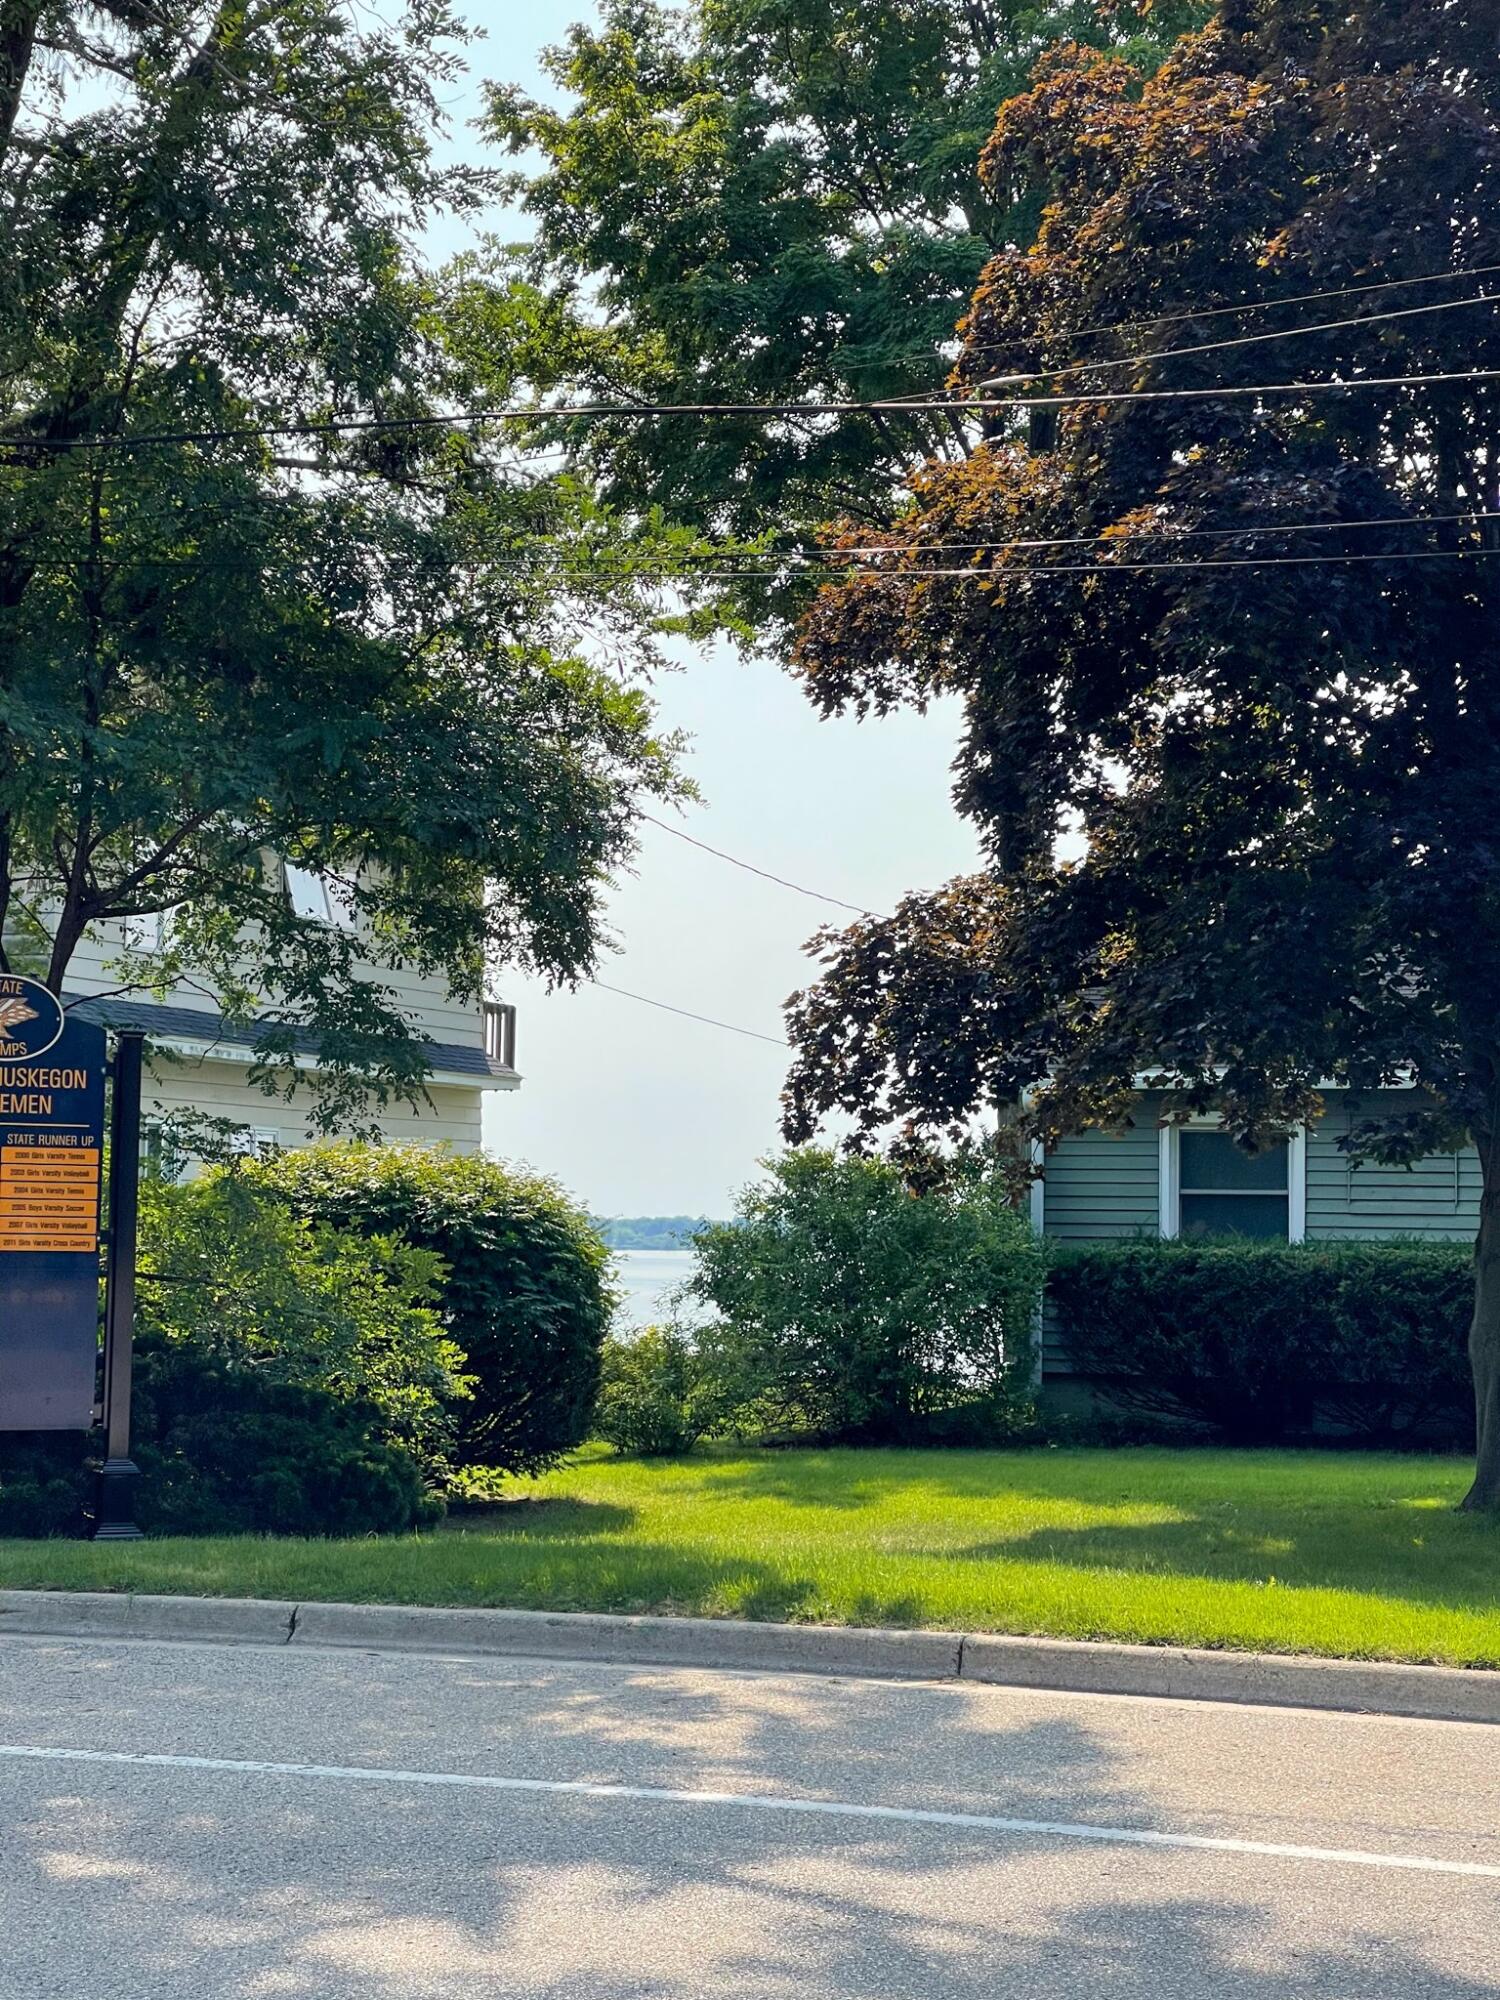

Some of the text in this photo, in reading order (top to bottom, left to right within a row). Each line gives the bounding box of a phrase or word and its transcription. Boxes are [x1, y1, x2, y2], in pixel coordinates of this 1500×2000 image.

[0, 980, 24, 995] ATE
[0, 1066, 87, 1089] USKEGON
[7, 1133, 95, 1147] STATE RUNNER UP
[47, 1152, 66, 1160] Varsity
[42, 1169, 61, 1177] Varsity
[63, 1170, 90, 1178] Volleyball
[31, 1186, 44, 1194] Girls
[46, 1187, 65, 1195] Varsity
[67, 1187, 85, 1195] Tennis
[29, 1204, 42, 1212] Boys
[44, 1204, 64, 1212] Varsity
[25, 1221, 38, 1229] Girls
[40, 1222, 60, 1230] Varsity
[62, 1222, 88, 1230] Volleyball
[33, 1239, 52, 1247] Varsity
[70, 1240, 91, 1248] Country
